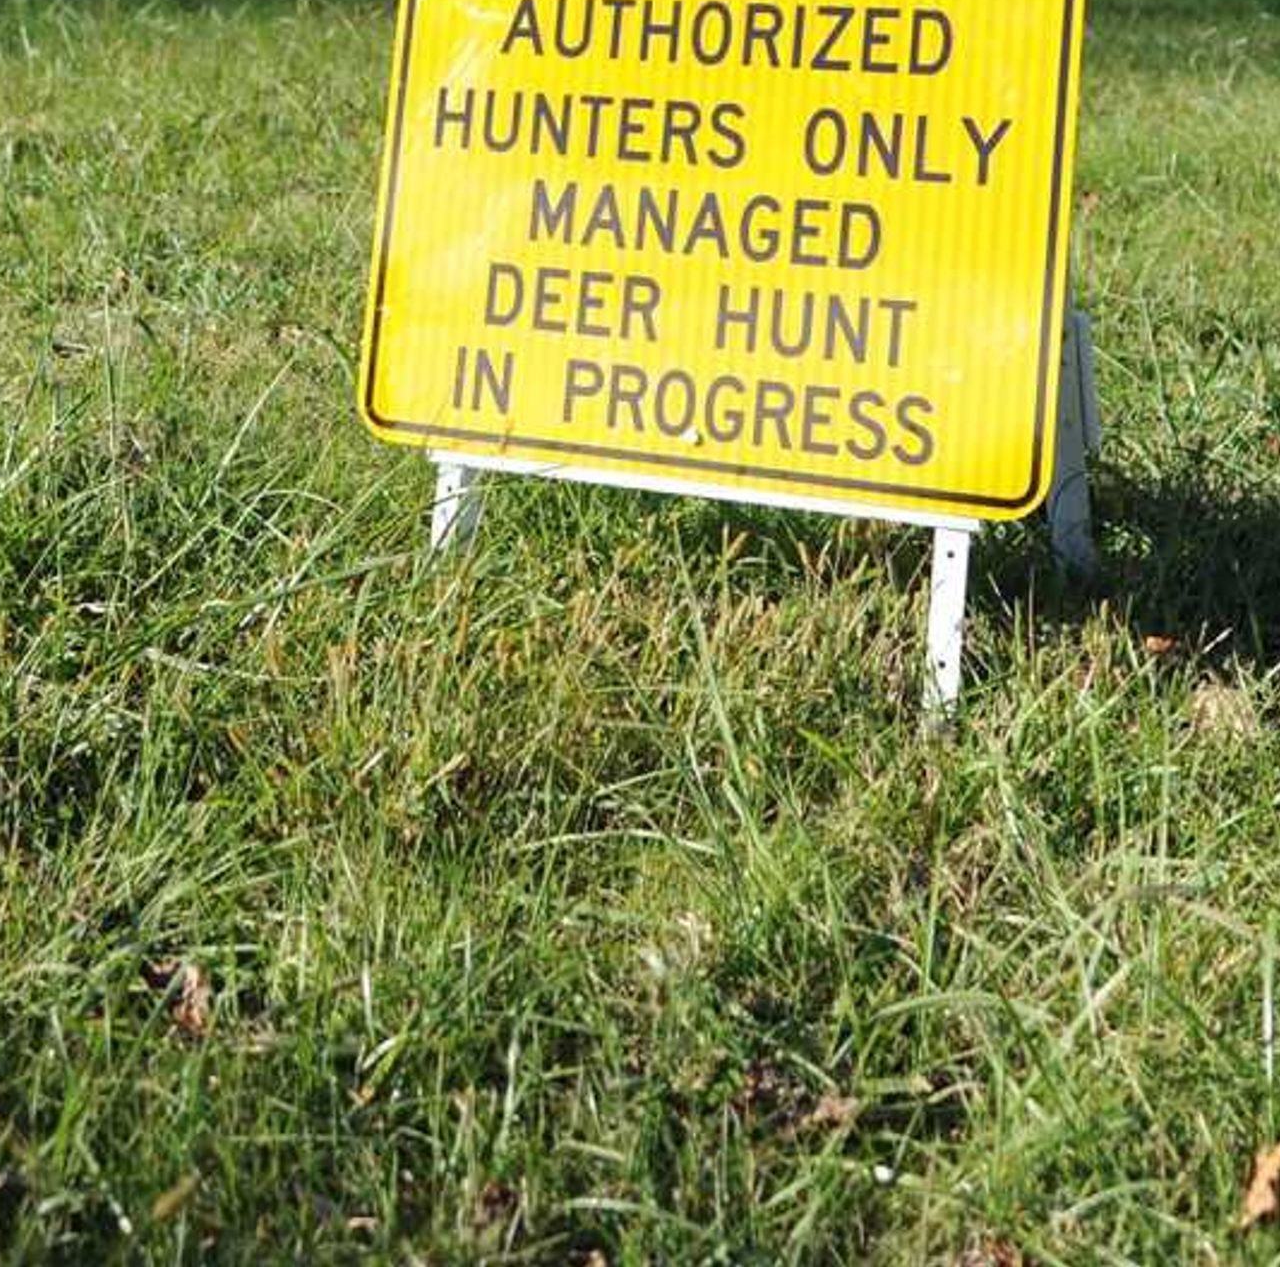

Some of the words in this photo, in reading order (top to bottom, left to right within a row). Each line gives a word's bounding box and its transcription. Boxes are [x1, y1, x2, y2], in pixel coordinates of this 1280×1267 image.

[435, 87, 745, 168] HUNTERS
[805, 108, 1011, 185] ONLY
[530, 180, 881, 269] MANAGED
[485, 263, 660, 341] DEER
[716, 285, 916, 367] HUNT
[454, 347, 512, 414] IN
[564, 360, 933, 465] PROGRESS
